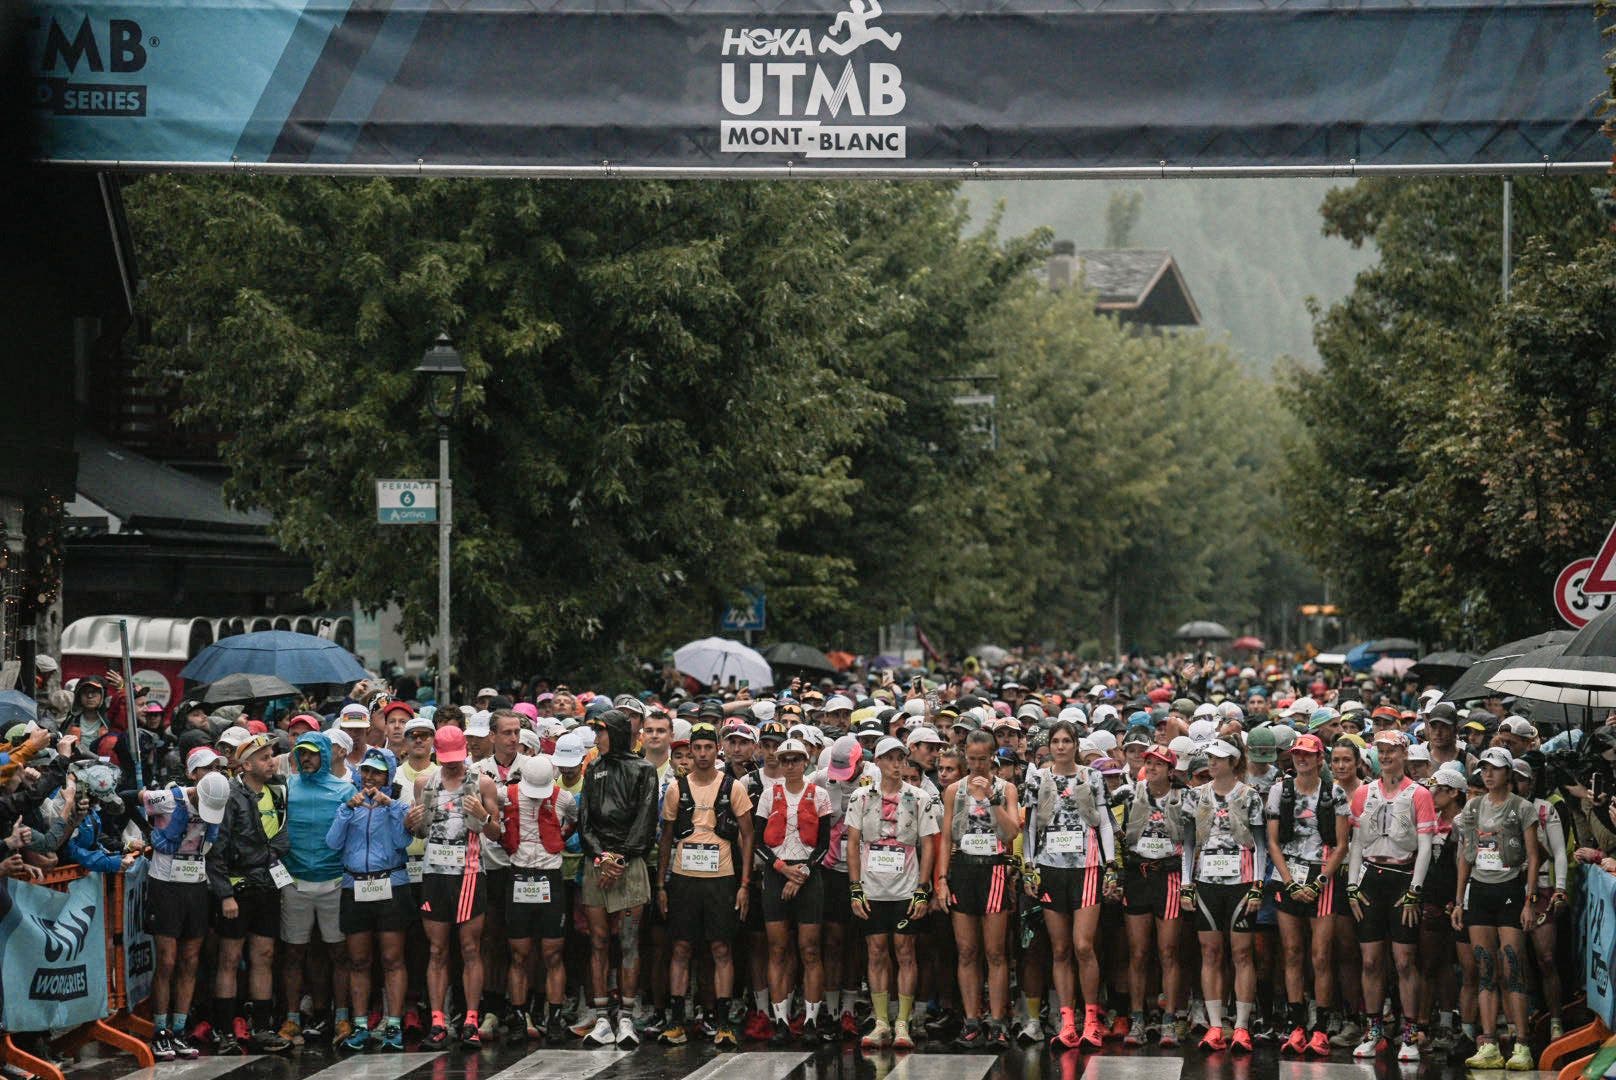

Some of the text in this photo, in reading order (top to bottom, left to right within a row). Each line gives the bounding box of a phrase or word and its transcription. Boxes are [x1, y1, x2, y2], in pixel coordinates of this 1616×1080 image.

[721, 28, 814, 56] HOKA
[721, 59, 906, 119] UTMB
[63, 91, 140, 111] SERIES
[728, 127, 899, 152] MONT-BLANC
[382, 482, 432, 490] FERMATA
[403, 494, 410, 504] 6
[181, 865, 198, 873] 3002
